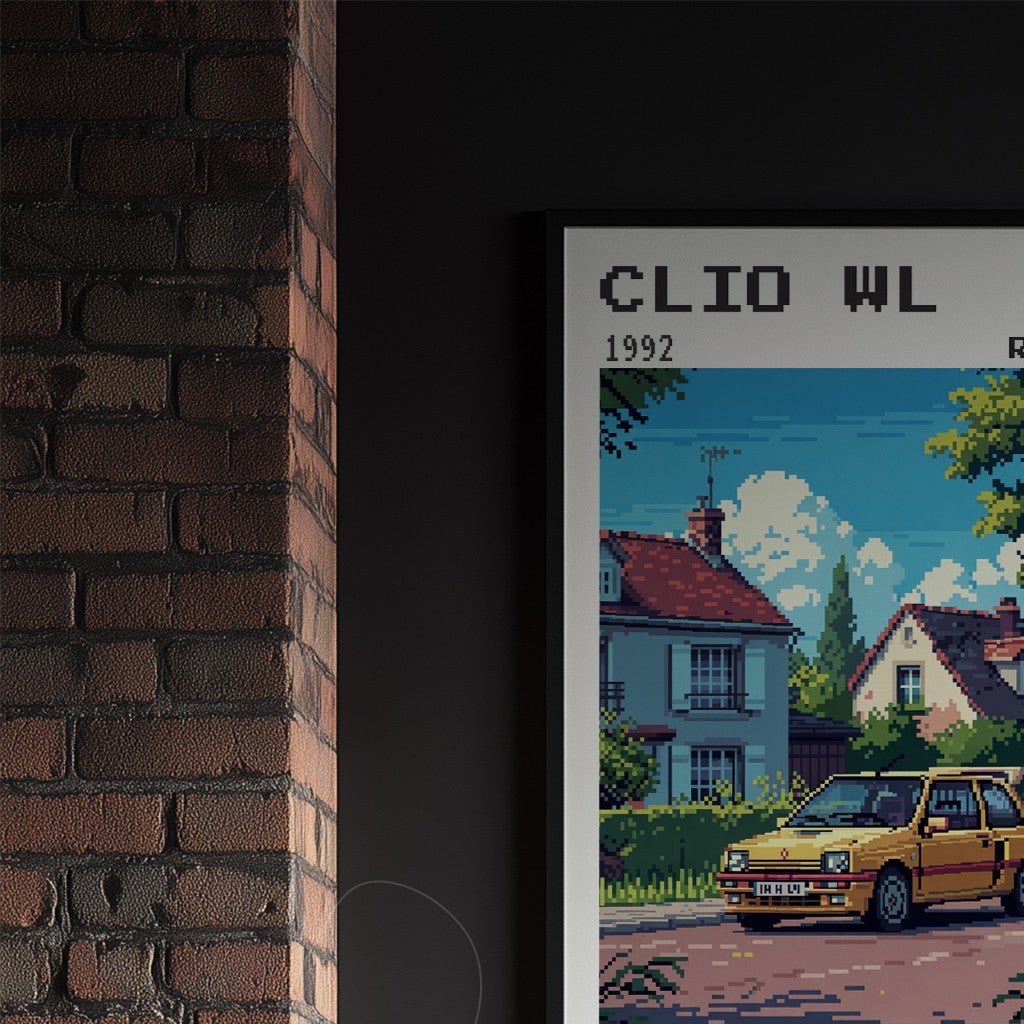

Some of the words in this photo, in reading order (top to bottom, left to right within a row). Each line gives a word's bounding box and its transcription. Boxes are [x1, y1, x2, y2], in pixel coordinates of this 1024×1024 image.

[599, 265, 791, 313] CLIO
[843, 265, 937, 313] WL
[606, 334, 673, 362] 1992
